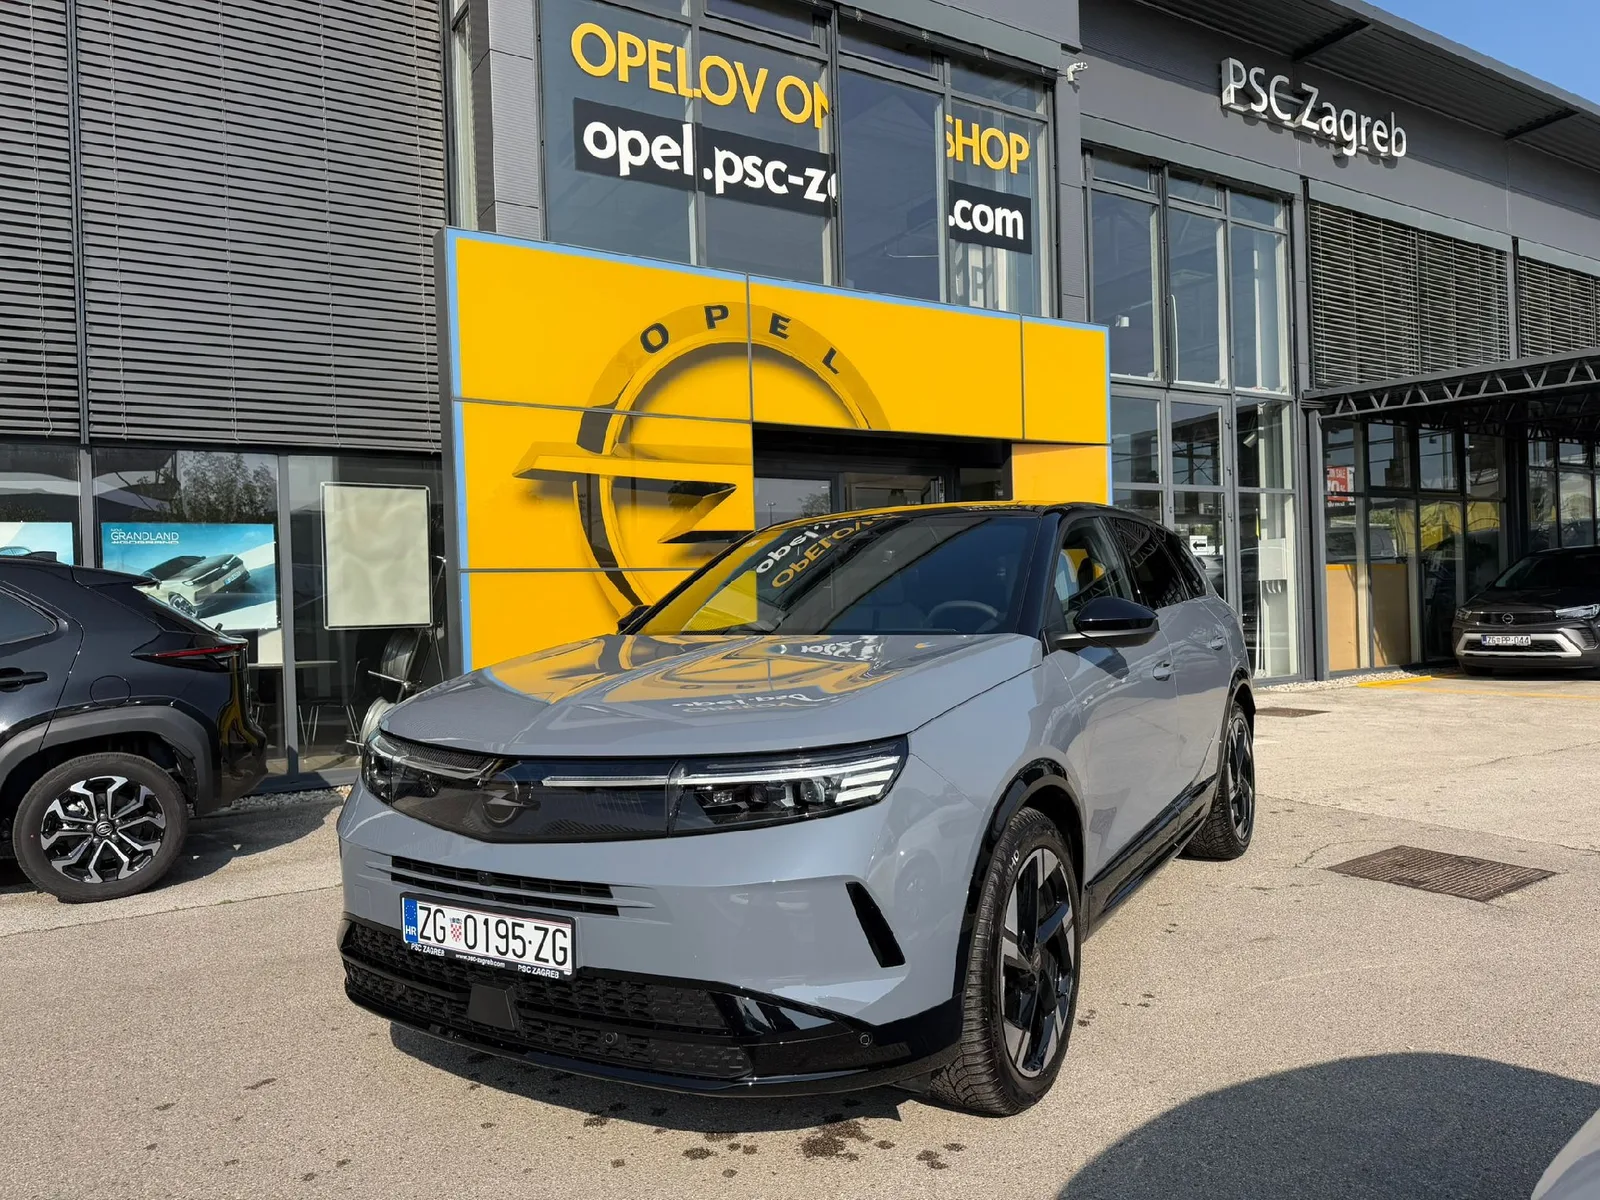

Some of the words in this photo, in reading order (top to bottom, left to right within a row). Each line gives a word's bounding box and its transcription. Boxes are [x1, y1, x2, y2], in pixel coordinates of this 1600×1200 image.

[570, 23, 769, 113] OPELOV
[1221, 57, 1292, 122] PSC
[1301, 82, 1407, 157] Zagreb
[640, 304, 840, 375] OPEL
[110, 531, 180, 541] GRANDLAND
[405, 925, 417, 936] HR
[418, 905, 447, 944] ZG
[411, 942, 423, 953] PSC
[422, 944, 446, 957] ZAGREB
[517, 964, 532, 974] PSC
[532, 966, 560, 979] ZAGREB
